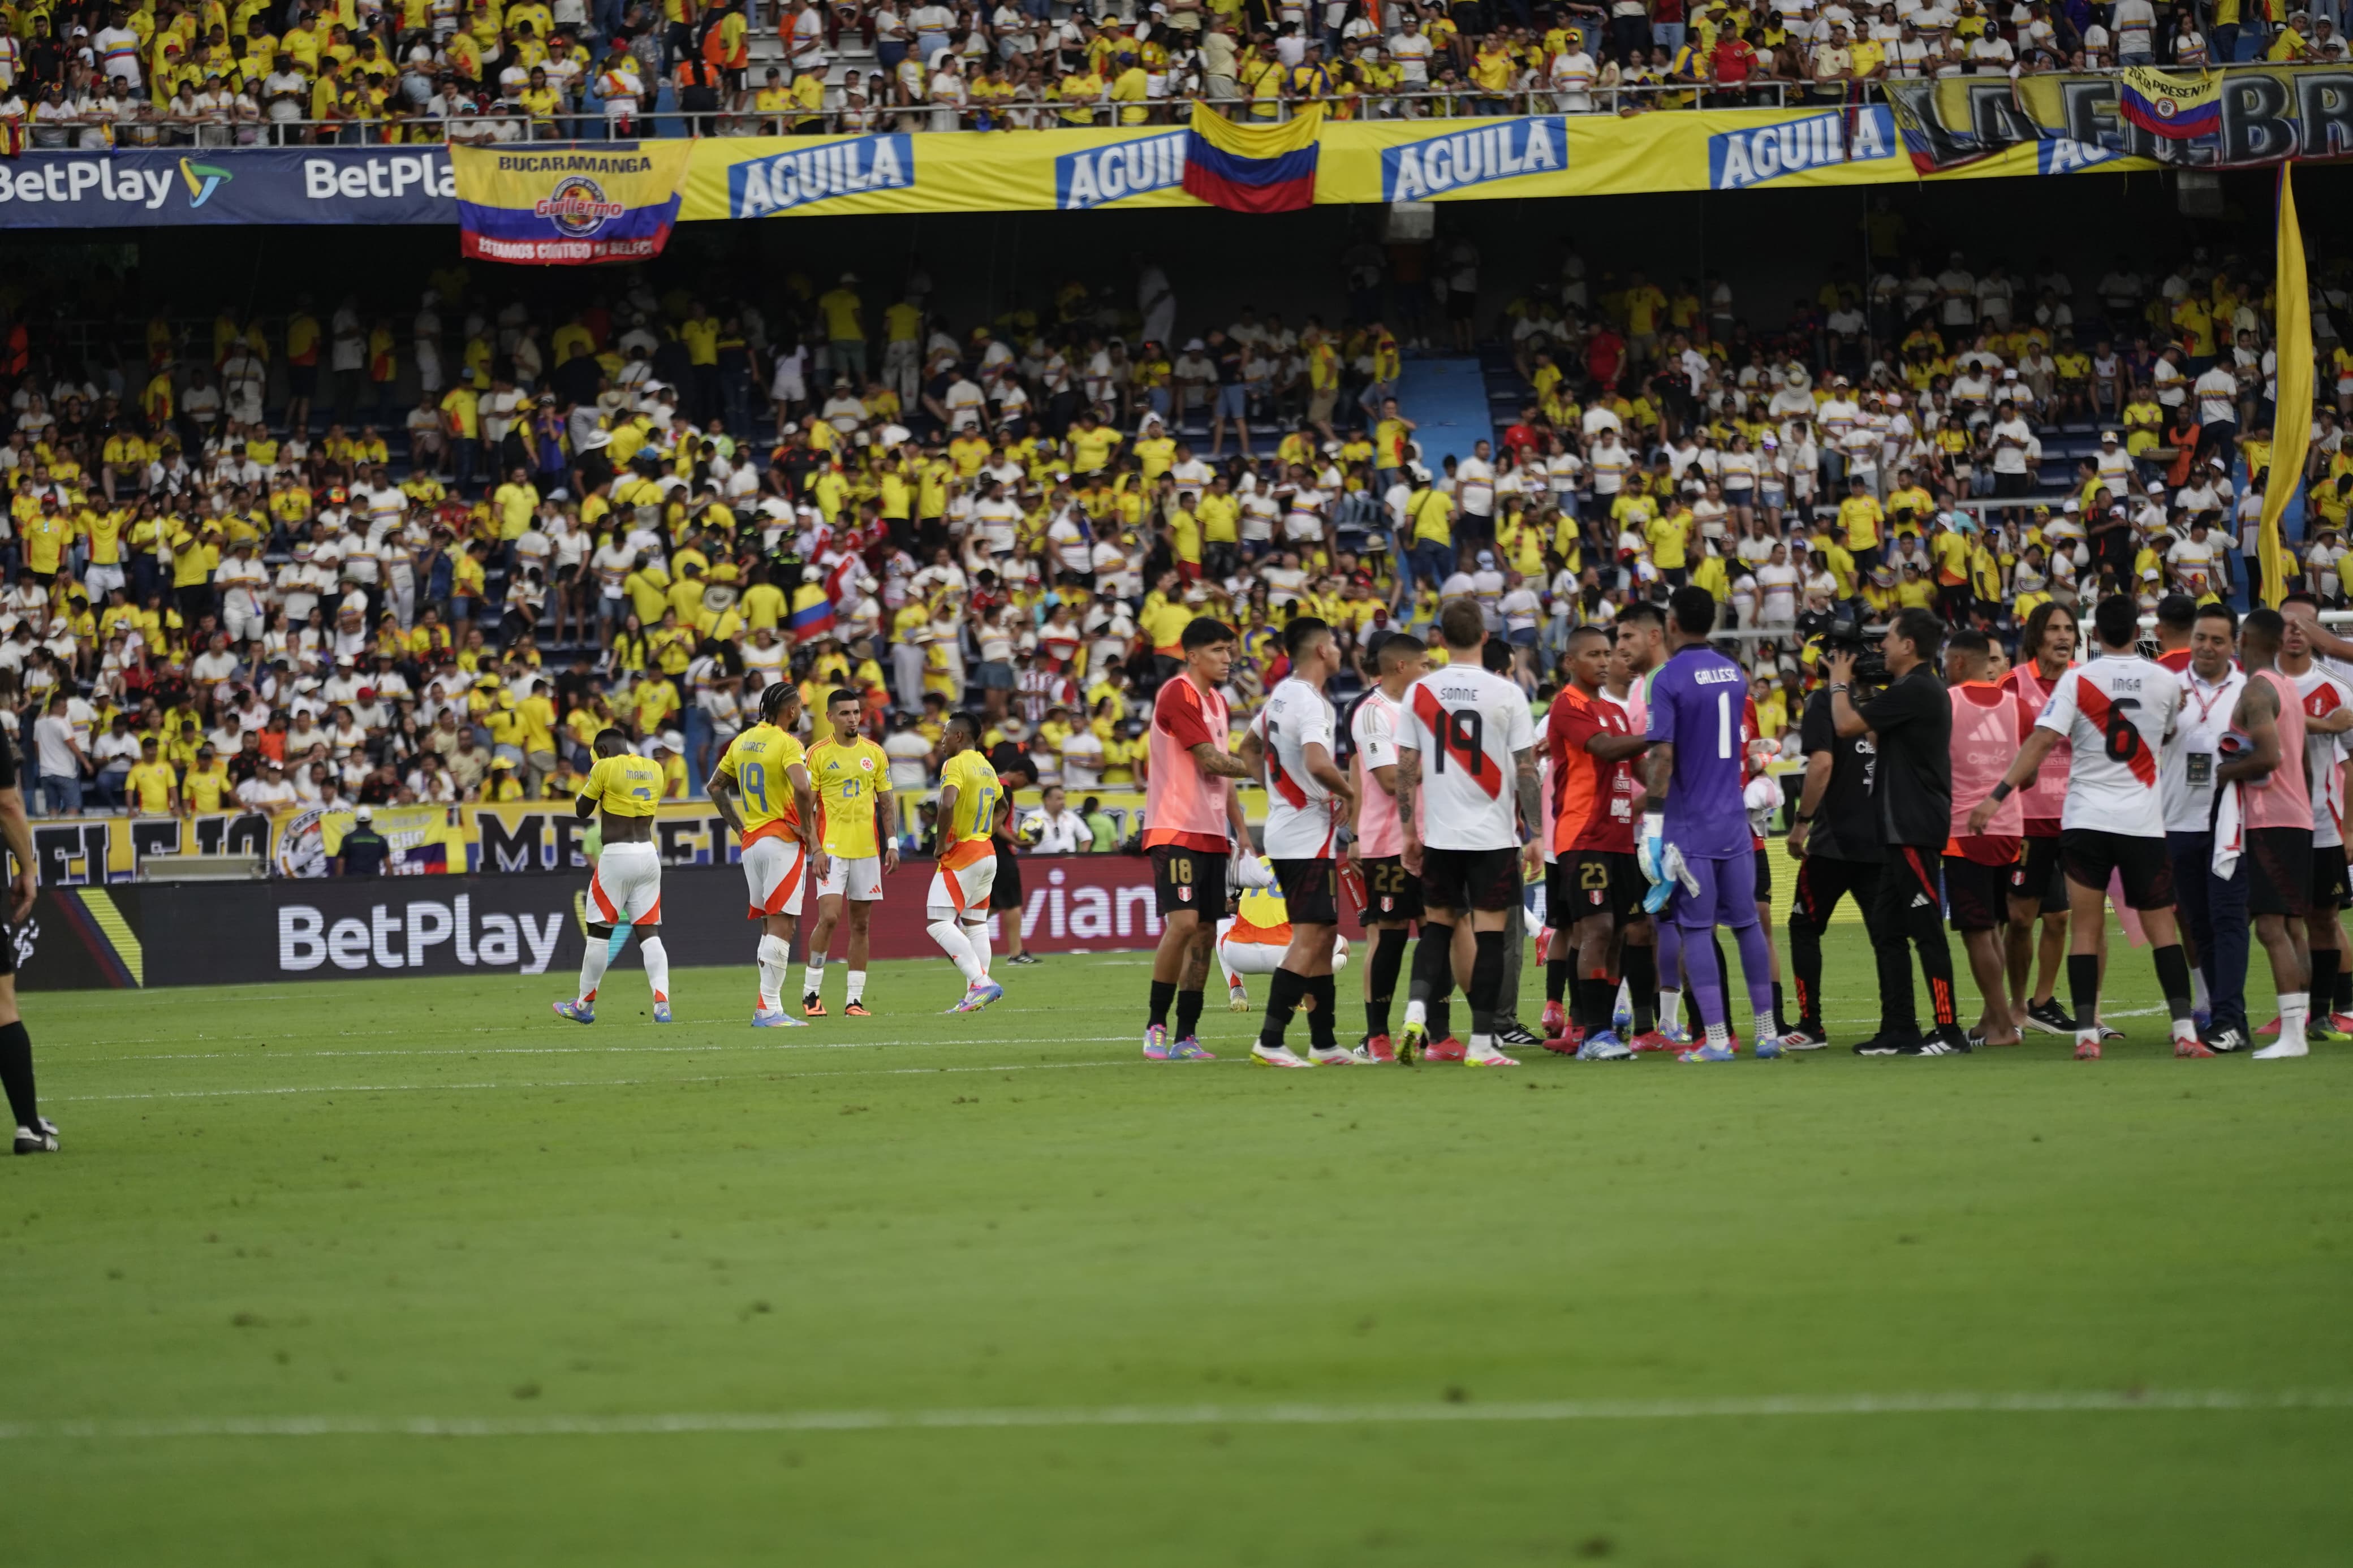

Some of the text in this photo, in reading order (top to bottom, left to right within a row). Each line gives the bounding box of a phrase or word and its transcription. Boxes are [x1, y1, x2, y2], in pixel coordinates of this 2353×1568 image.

[304, 154, 458, 198] BetPla
[499, 157, 652, 172] BUCARAMANGA
[742, 136, 906, 218] AGUILA
[1067, 135, 1186, 209] AGUI
[1393, 119, 1558, 202] AGUILA
[536, 198, 623, 216] Guillermo
[1696, 668, 1739, 685] GALLESE
[2113, 678, 2141, 692] INGA
[1440, 689, 1479, 702] SONNE
[1435, 710, 1483, 775] 19
[1718, 691, 1732, 759] 1
[2105, 698, 2141, 762] 6
[740, 741, 766, 753] SUAREZ
[740, 762, 769, 813] 19
[843, 779, 860, 797] 21
[972, 787, 994, 834] 17
[1170, 858, 1192, 884] 18
[1375, 864, 1406, 892] 22
[1580, 863, 1608, 889] 23
[279, 893, 564, 975] BetPlay
